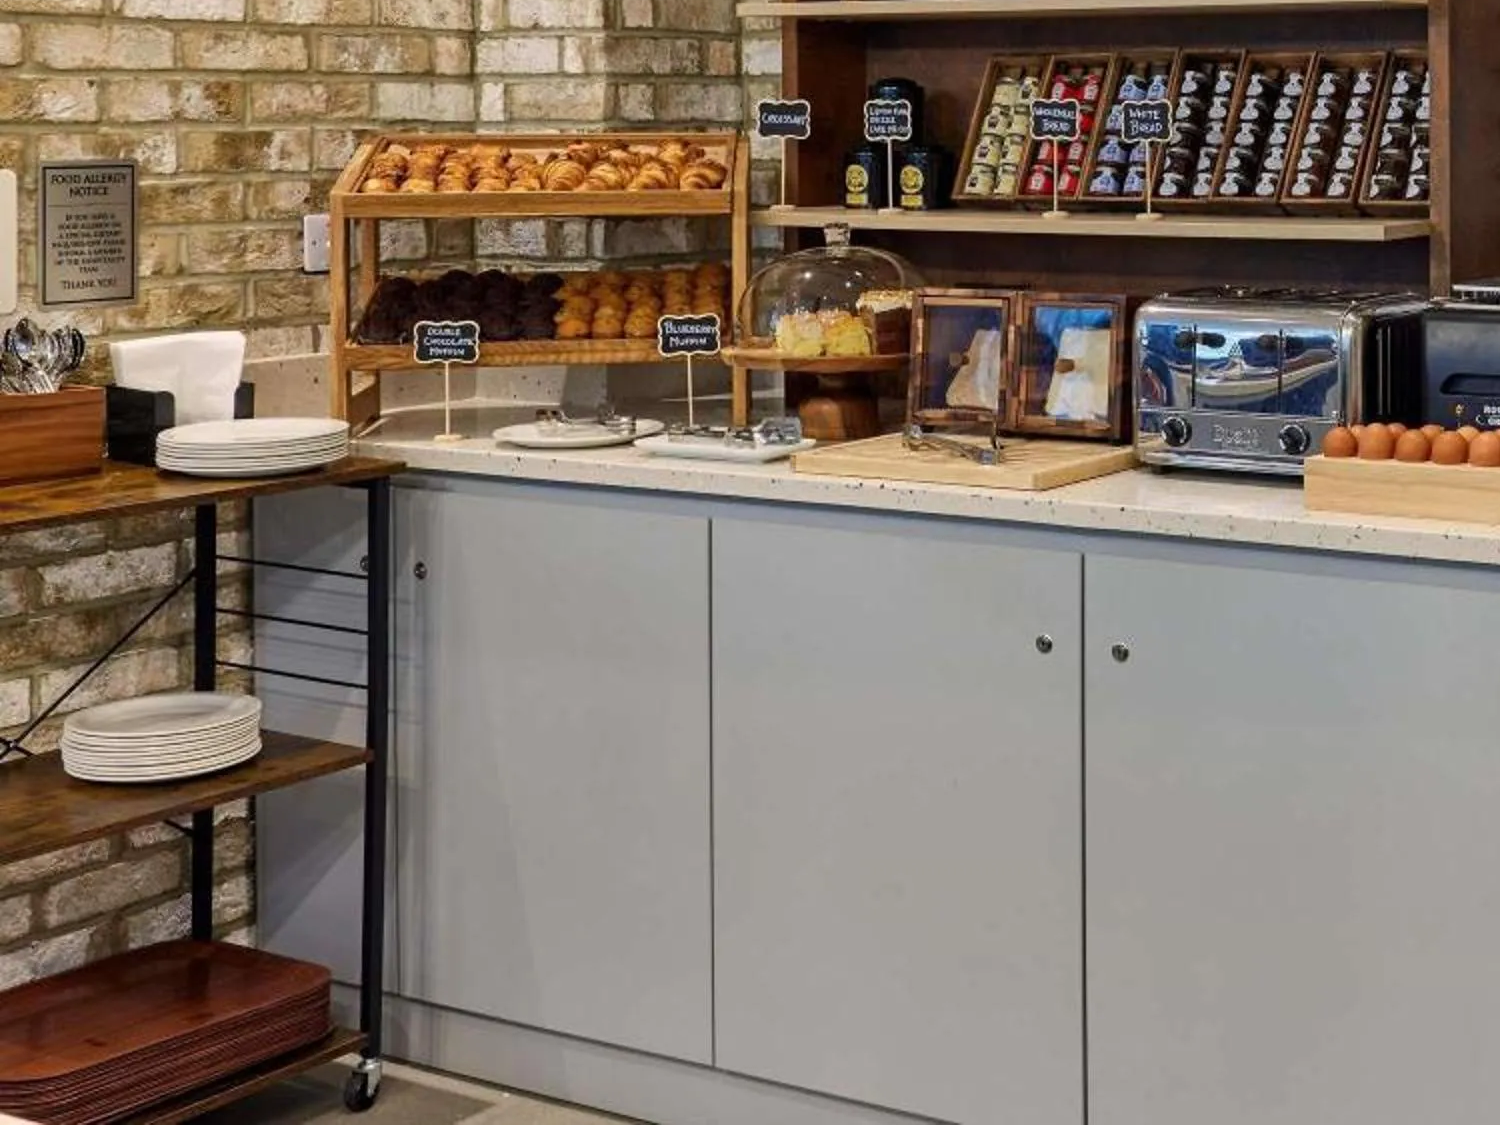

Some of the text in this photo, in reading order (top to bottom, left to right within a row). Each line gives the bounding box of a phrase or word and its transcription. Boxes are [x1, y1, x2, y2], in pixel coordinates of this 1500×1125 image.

[51, 174, 81, 185] FOOD
[69, 186, 108, 197] NOTICE
[62, 279, 96, 290] THANK
